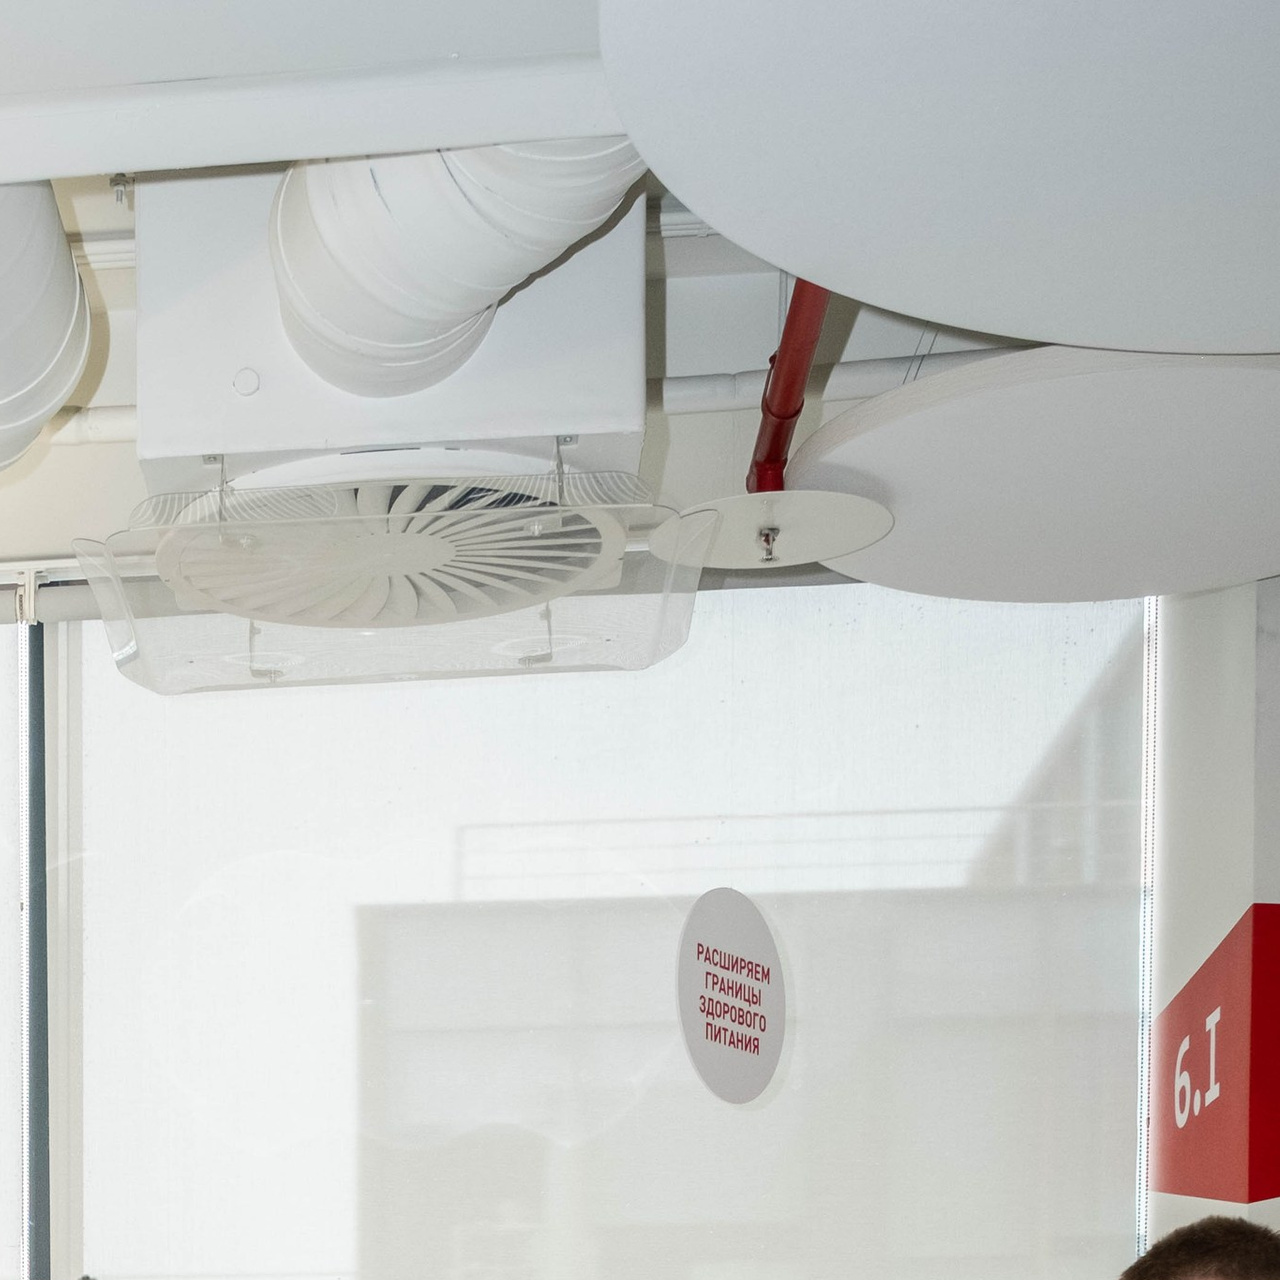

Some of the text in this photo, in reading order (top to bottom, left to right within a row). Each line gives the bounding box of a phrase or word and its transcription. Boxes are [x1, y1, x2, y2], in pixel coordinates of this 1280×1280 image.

[696, 942, 771, 985] РАСШИРЯЕМ
[705, 971, 762, 1007] ГРАНИЦЫ
[699, 995, 767, 1033] ЗДОРОВОГО
[705, 1021, 760, 1056] ПИТАНИЯ
